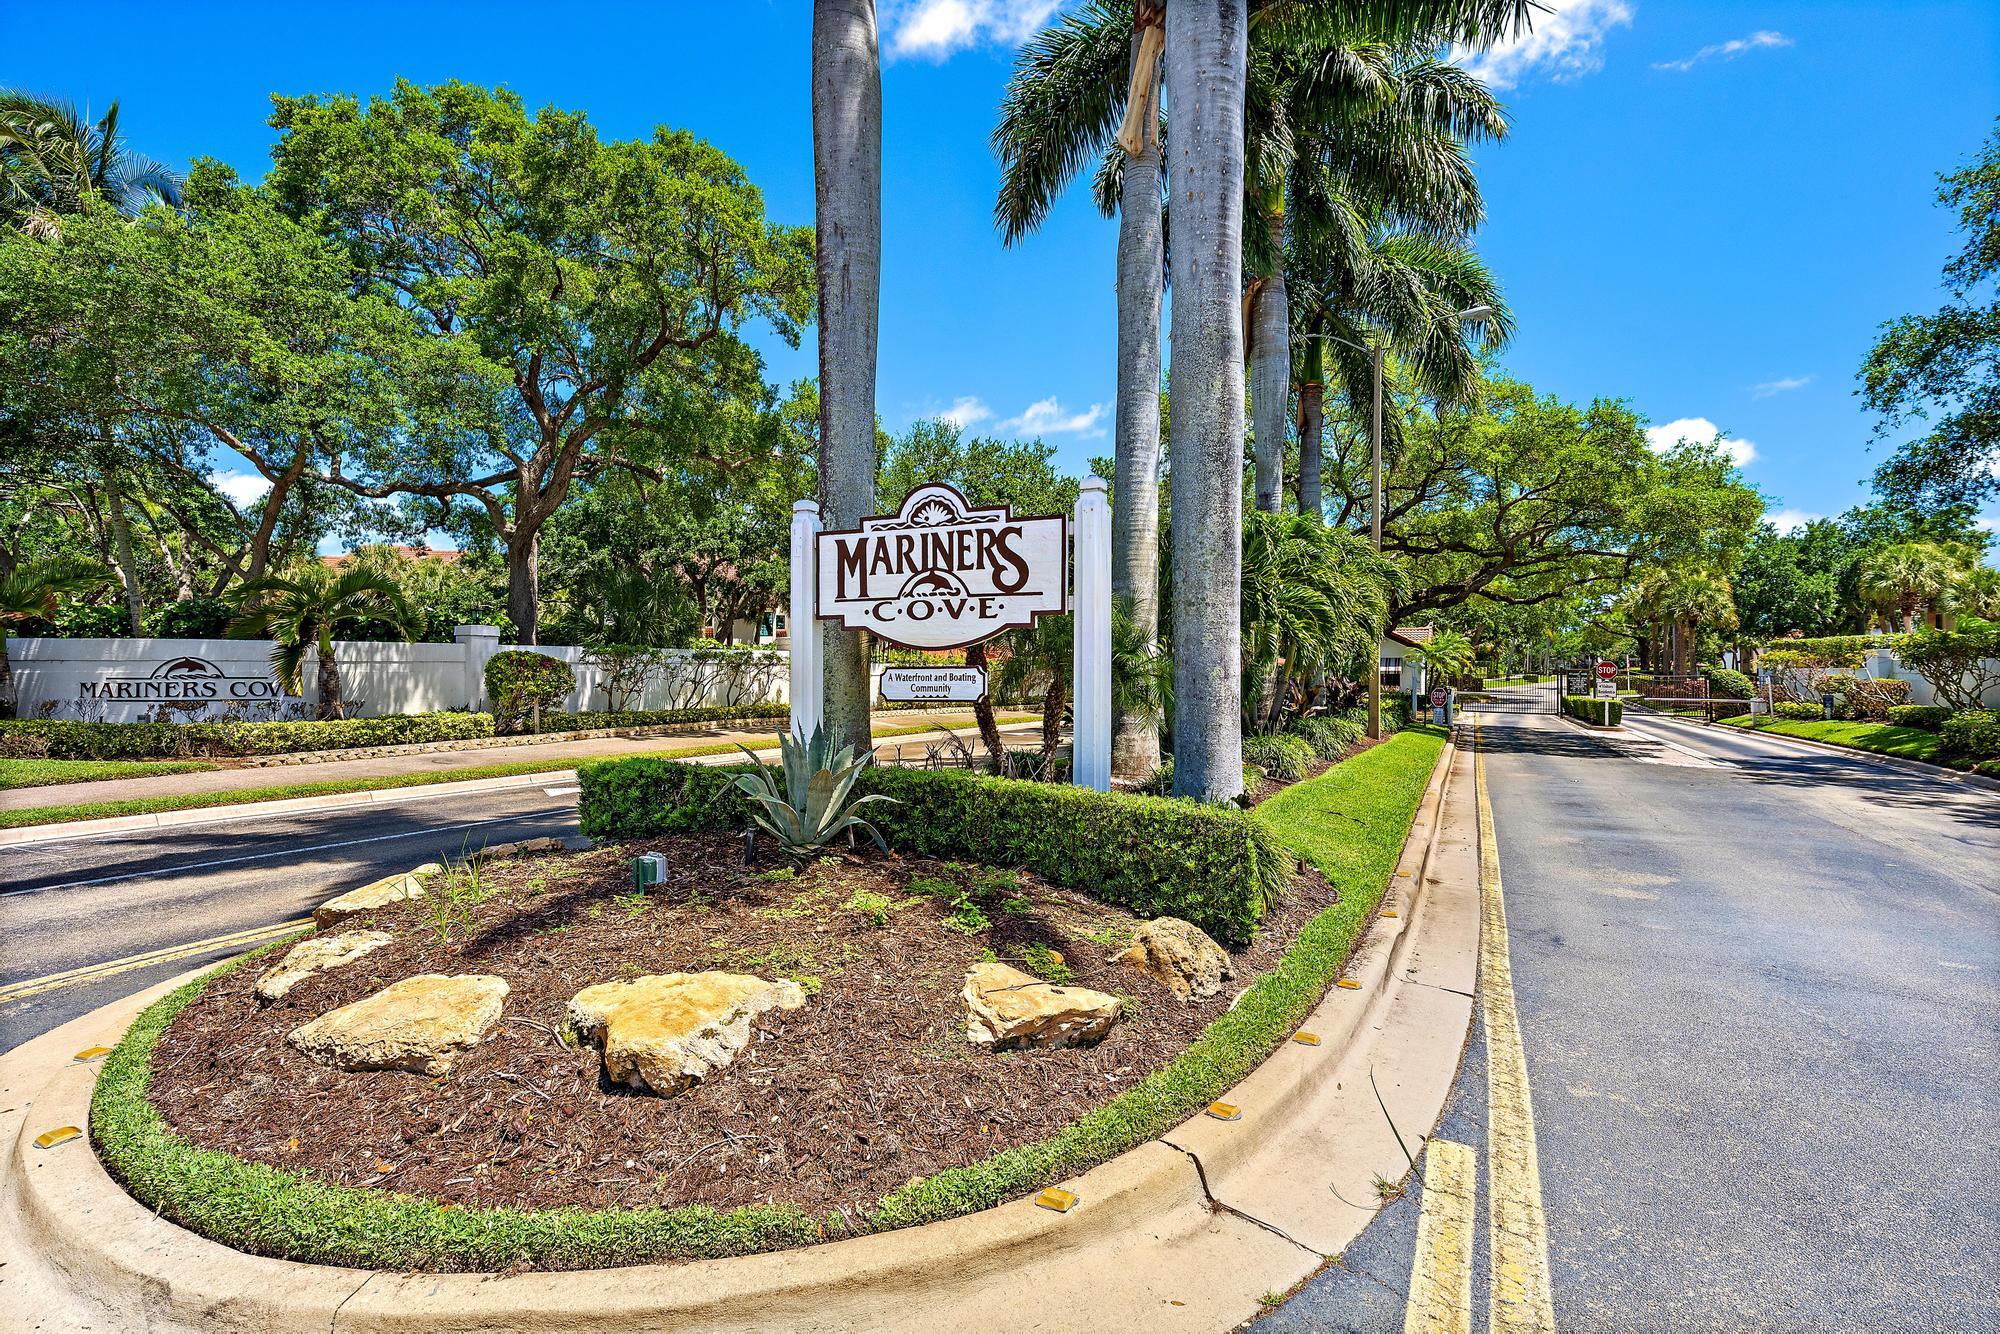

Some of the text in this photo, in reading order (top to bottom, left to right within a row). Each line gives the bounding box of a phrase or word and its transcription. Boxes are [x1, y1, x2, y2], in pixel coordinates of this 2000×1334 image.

[835, 526, 1029, 598] MARINERS
[1598, 666, 1616, 674] STOP
[888, 673, 977, 684] A Waterfront and Boating
[79, 681, 302, 698] MARINERS COV
[910, 683, 952, 695] Community
